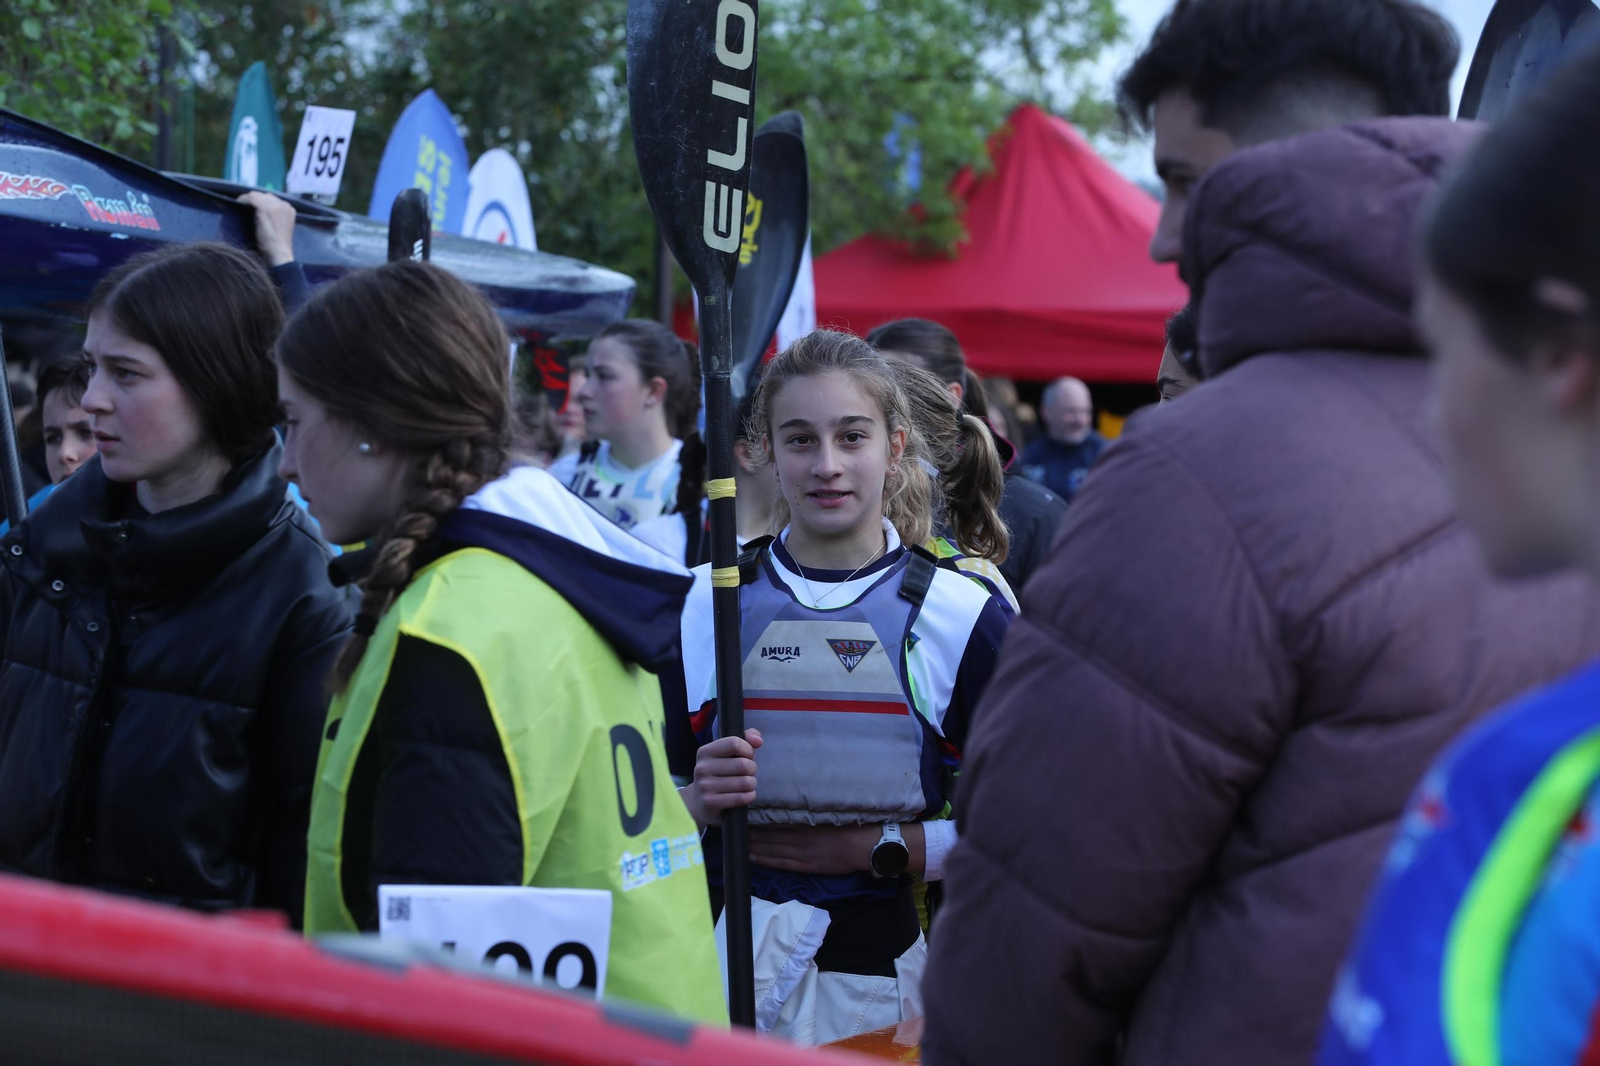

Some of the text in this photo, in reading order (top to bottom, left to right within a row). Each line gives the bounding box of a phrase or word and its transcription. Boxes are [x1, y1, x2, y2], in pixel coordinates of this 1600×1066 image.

[703, 0, 755, 254] ELIO
[304, 134, 345, 178] 195
[760, 646, 801, 658] AMURA
